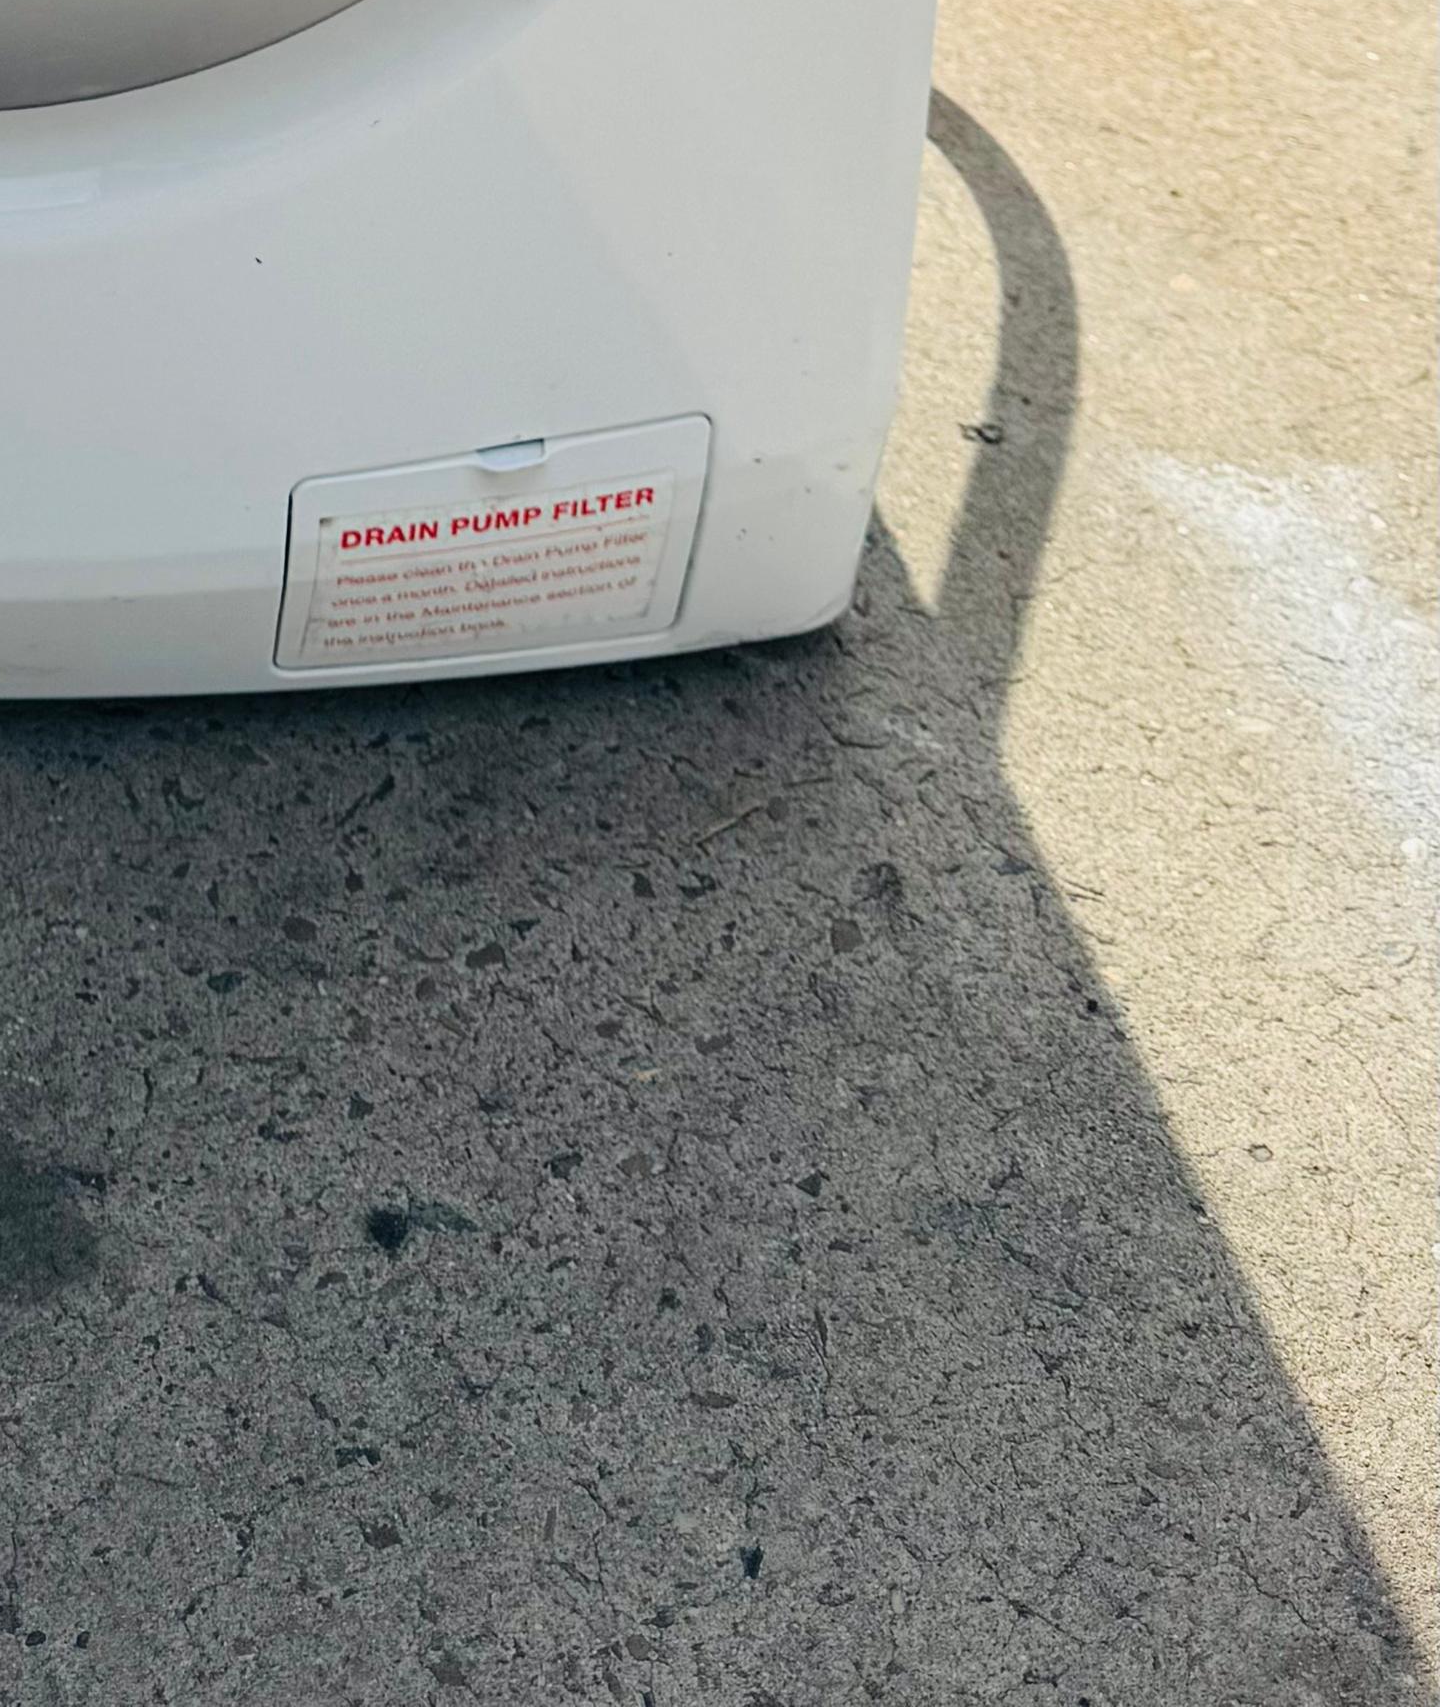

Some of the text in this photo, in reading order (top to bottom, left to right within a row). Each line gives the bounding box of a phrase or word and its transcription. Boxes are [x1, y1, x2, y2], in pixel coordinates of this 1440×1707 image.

[340, 487, 655, 550] DRAIN PUMP FILTER
